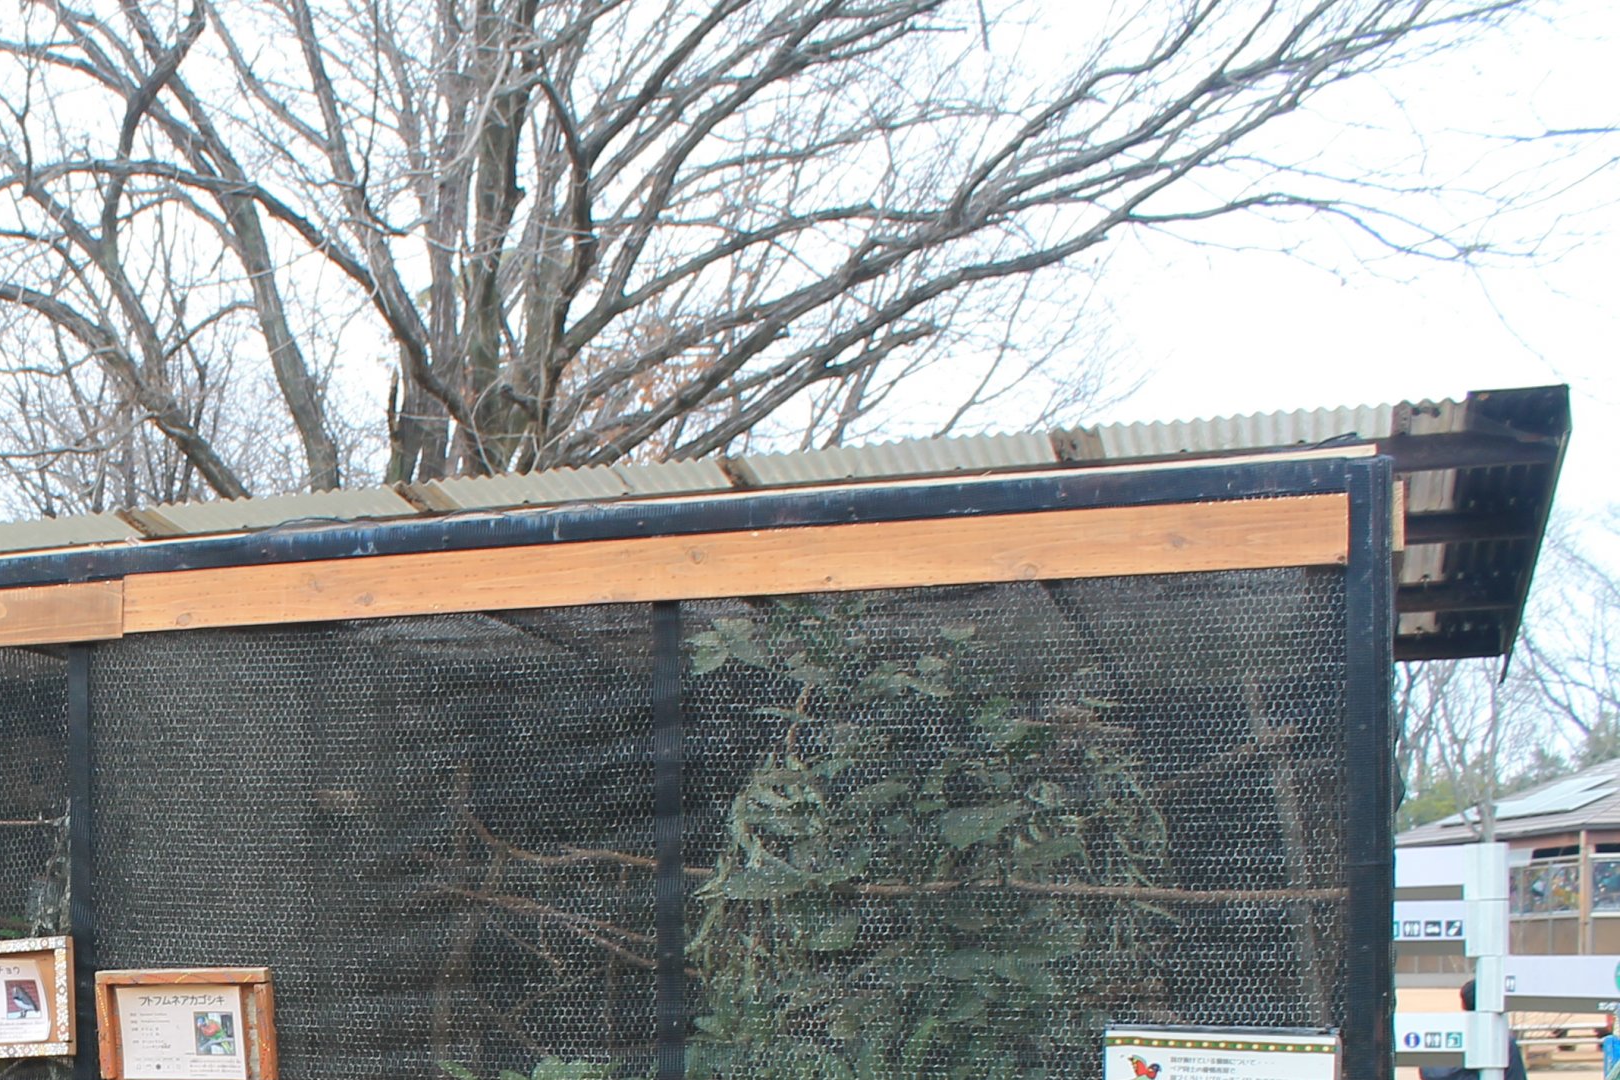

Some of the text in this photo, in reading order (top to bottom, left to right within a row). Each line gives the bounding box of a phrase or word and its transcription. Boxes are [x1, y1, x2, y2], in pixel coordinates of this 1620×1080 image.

[138, 994, 225, 1007] フトフムネアカゴシキ
